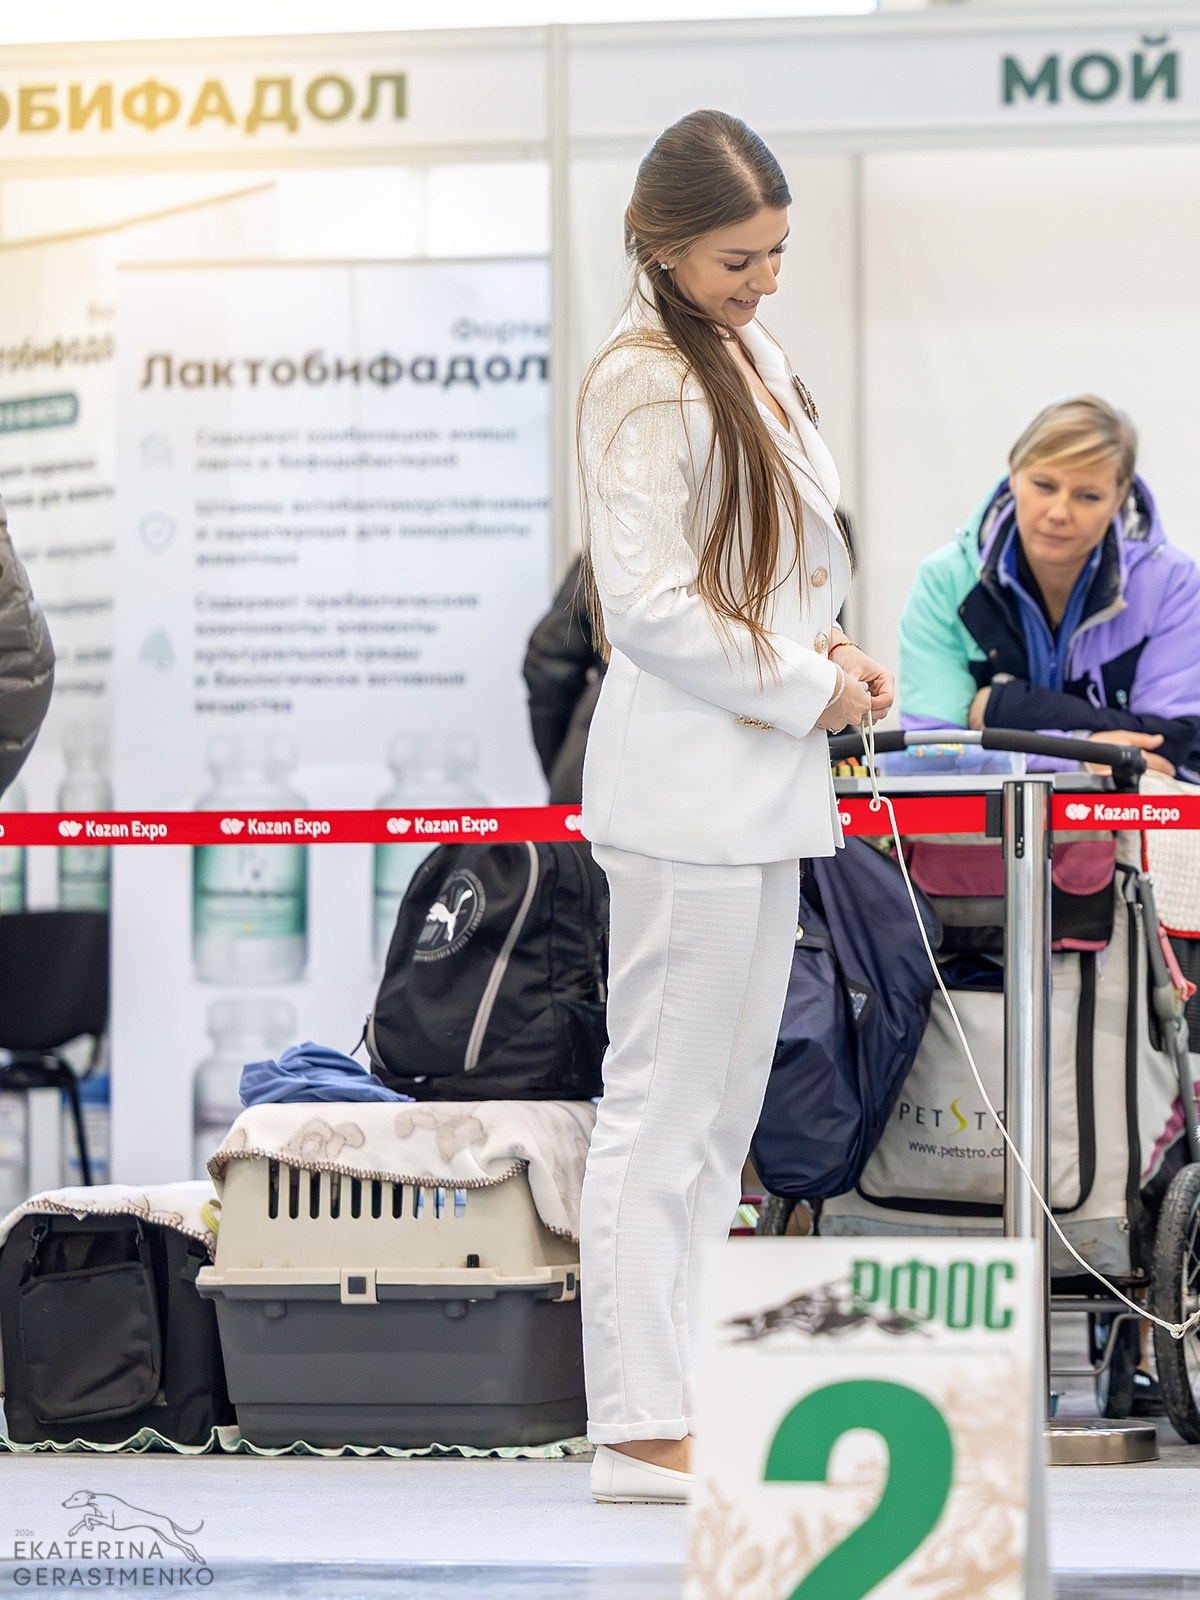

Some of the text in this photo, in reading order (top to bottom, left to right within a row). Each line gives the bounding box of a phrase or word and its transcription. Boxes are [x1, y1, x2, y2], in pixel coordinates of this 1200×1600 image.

[1001, 35, 1179, 105] МОЙ
[0, 72, 409, 134] БИФАДОЛ
[140, 347, 550, 391] Лактобифадол
[85, 819, 168, 840] Kazan Expo
[247, 817, 331, 838] Kazan Expo
[414, 815, 499, 836] Kazan Expo
[1094, 803, 1180, 825] Kazan Expo
[764, 1377, 955, 1600] 2
